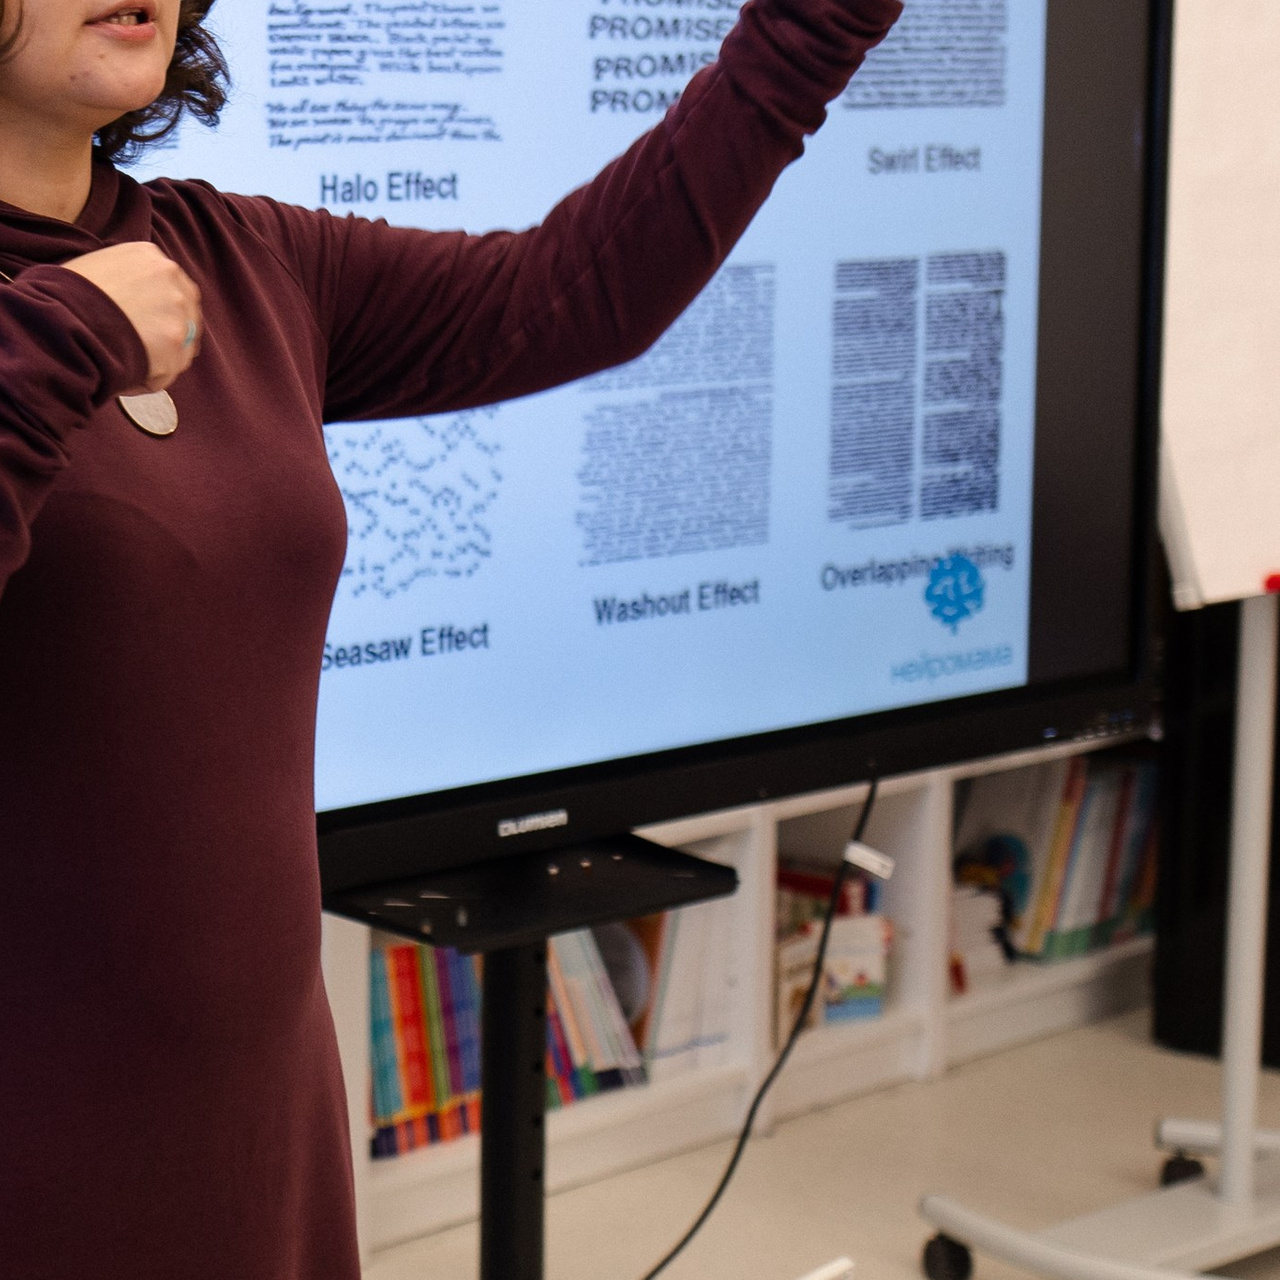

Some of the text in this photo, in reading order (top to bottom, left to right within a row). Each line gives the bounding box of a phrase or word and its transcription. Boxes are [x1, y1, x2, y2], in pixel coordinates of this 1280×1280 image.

[588, 16, 732, 41] PROMISE
[593, 52, 718, 81] PROMIS
[868, 143, 982, 174] Swirl Effect
[320, 171, 458, 204] Halo Effect
[592, 578, 761, 628] Washout Effect
[322, 621, 490, 672] Seasaw Effect
